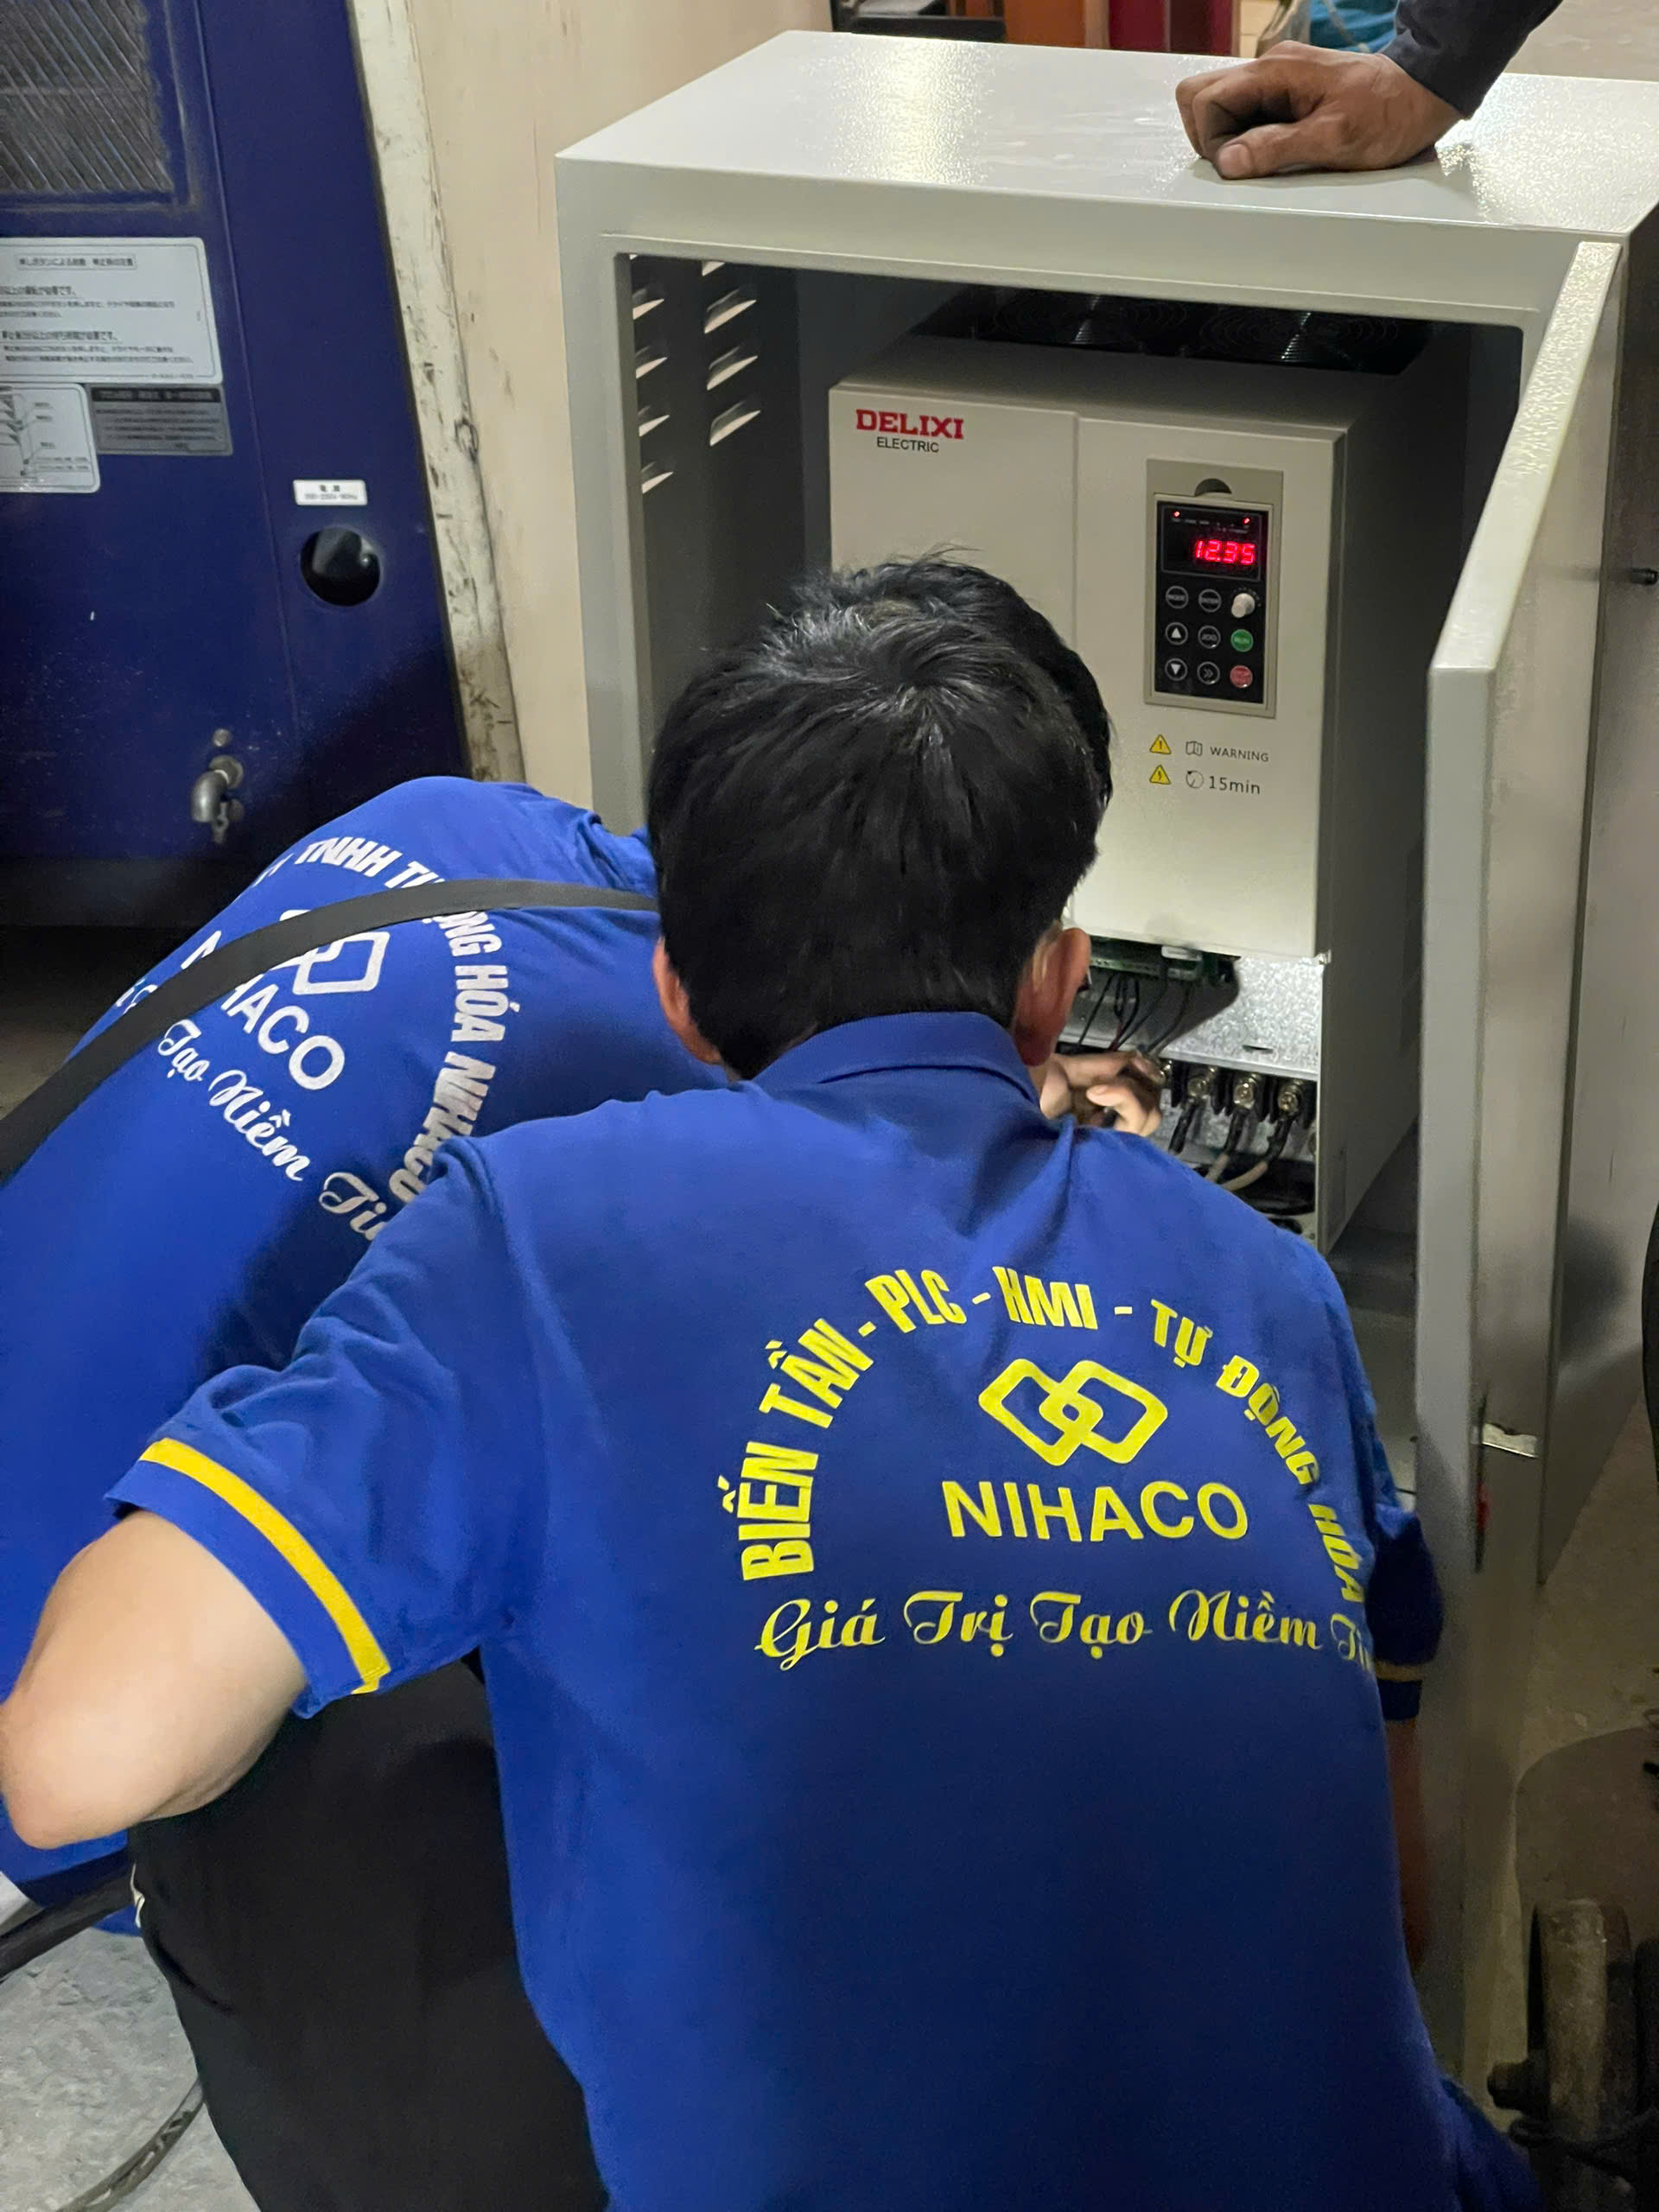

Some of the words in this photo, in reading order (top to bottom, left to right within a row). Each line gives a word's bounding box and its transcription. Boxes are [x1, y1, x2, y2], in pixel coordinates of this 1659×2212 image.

[855, 409, 965, 440] DELIXI
[876, 435, 940, 453] ELECTRIC
[1209, 775, 1261, 795] 15min
[1210, 746, 1269, 762] WARNING
[295, 836, 404, 878] TNHH
[421, 910, 503, 957] NG
[450, 965, 521, 1042] HÓA
[157, 1019, 211, 1082] Tạo
[207, 1069, 311, 1182] Niềm
[864, 1269, 967, 1334] PLC
[992, 1265, 1099, 1331] HMI
[1150, 1299, 1214, 1368] TỰ
[758, 1317, 874, 1429] TẦN
[718, 1440, 819, 1582] BIẾN
[941, 1480, 1249, 1542] NIHACO
[754, 1599, 887, 1671] Giá
[904, 1590, 1014, 1658] Trị
[1028, 1591, 1152, 1661] Tạo
[1167, 1588, 1324, 1651] Niềm
